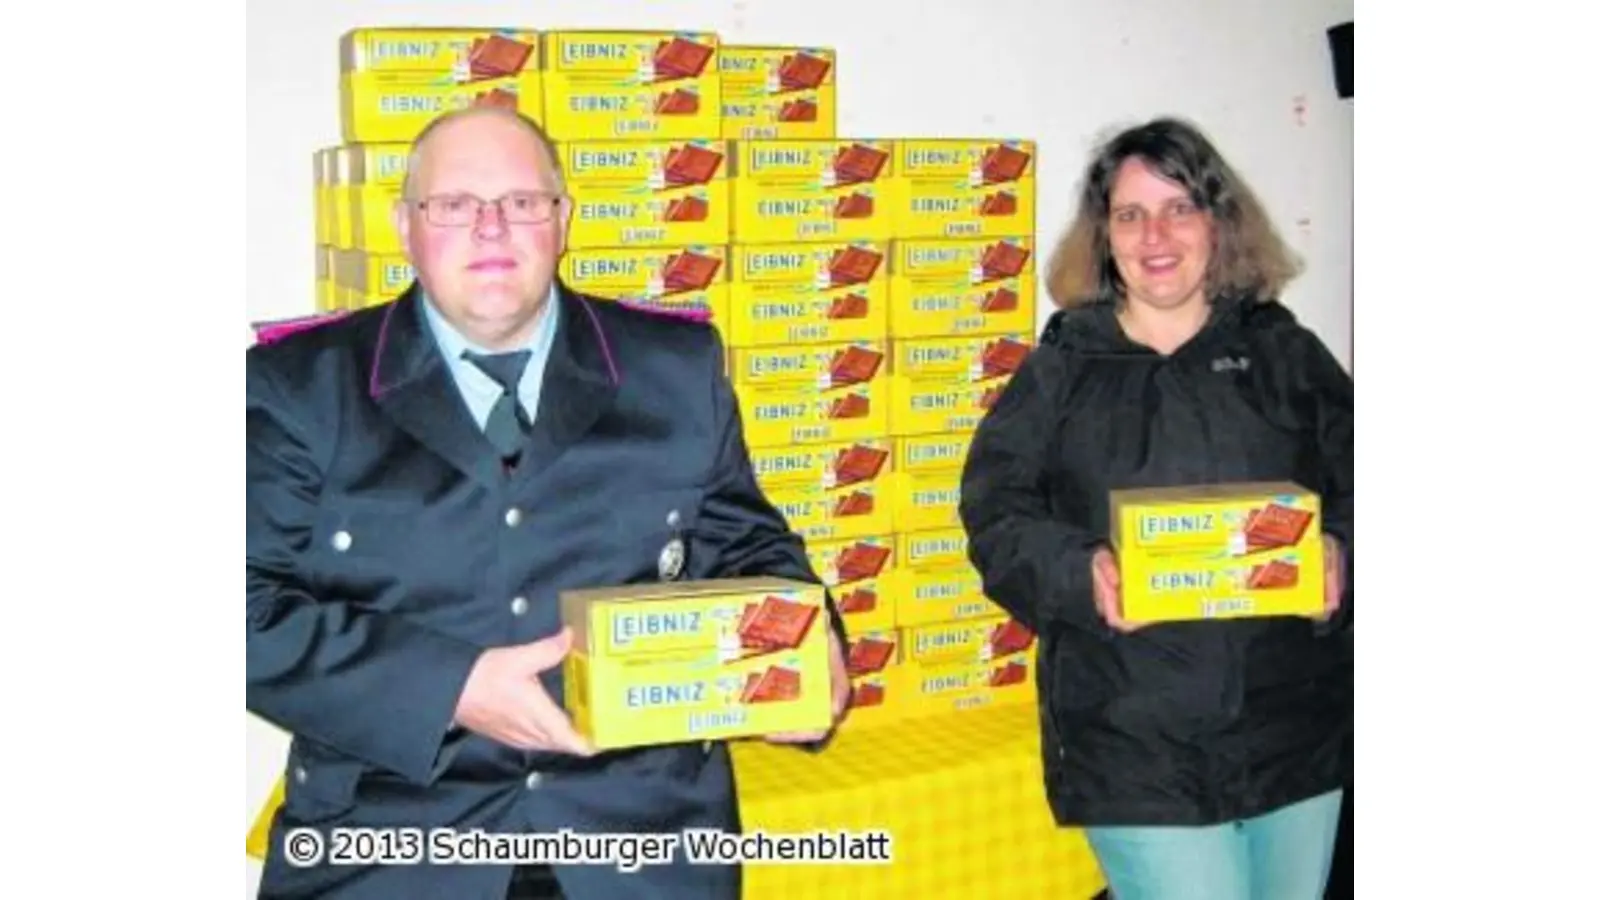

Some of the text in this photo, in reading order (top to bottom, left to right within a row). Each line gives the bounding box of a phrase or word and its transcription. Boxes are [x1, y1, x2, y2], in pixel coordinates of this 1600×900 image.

[573, 151, 637, 173] LEIBNIZ
[573, 257, 637, 281] LEIBNIZ
[1140, 513, 1215, 540] LEIBNIZ
[615, 610, 700, 643] LEIBNIZ
